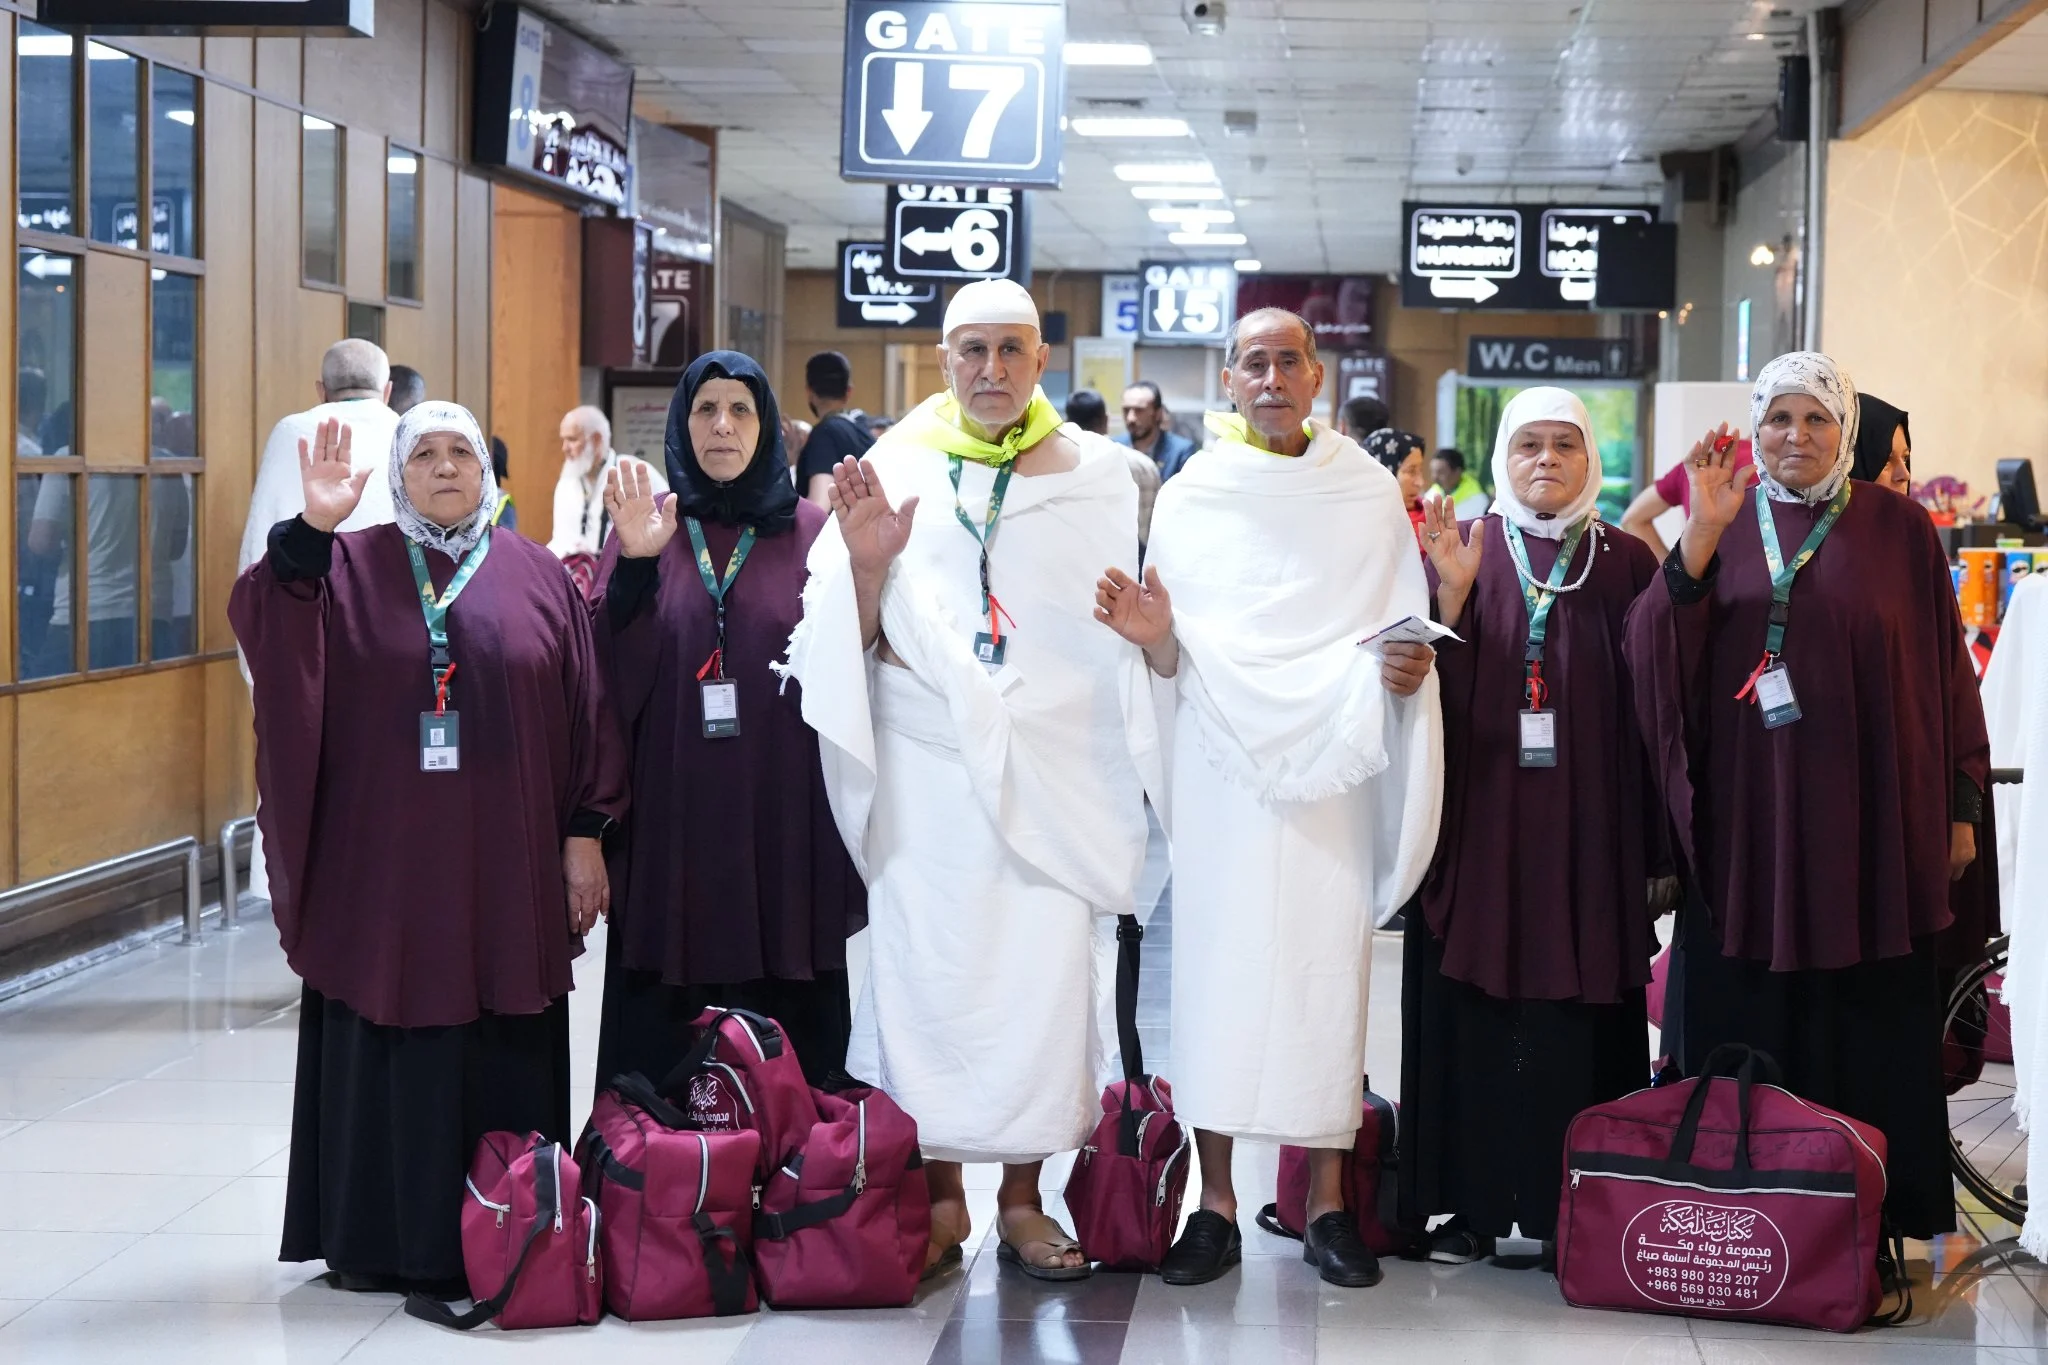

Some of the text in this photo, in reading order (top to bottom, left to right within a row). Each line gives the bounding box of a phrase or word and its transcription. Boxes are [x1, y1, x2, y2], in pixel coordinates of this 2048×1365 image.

[865, 11, 1045, 53] GATE
[949, 64, 1024, 159] 7
[898, 184, 1013, 204] GATE
[951, 209, 1000, 271] 6
[1417, 245, 1514, 266] NURSERY
[1548, 250, 1598, 271] MOS
[1145, 265, 1228, 287] GATE
[1116, 300, 1138, 332] 5
[1182, 288, 1220, 334] 5
[1341, 358, 1386, 372] GATE
[1478, 343, 1600, 373] W.C Men
[1636, 1248, 1660, 1261] صباغ
[1662, 1251, 1690, 1264] أسامة
[1698, 1241, 1722, 1256] رواء
[1726, 1244, 1772, 1259] مجموعة
[1693, 1255, 1740, 1269] المجموعة
[1646, 1266, 1759, 1286] +963 980 329 207
[1646, 1279, 1758, 1299] +966 569 030 481
[1679, 1294, 1726, 1306] حجاج سوريا
